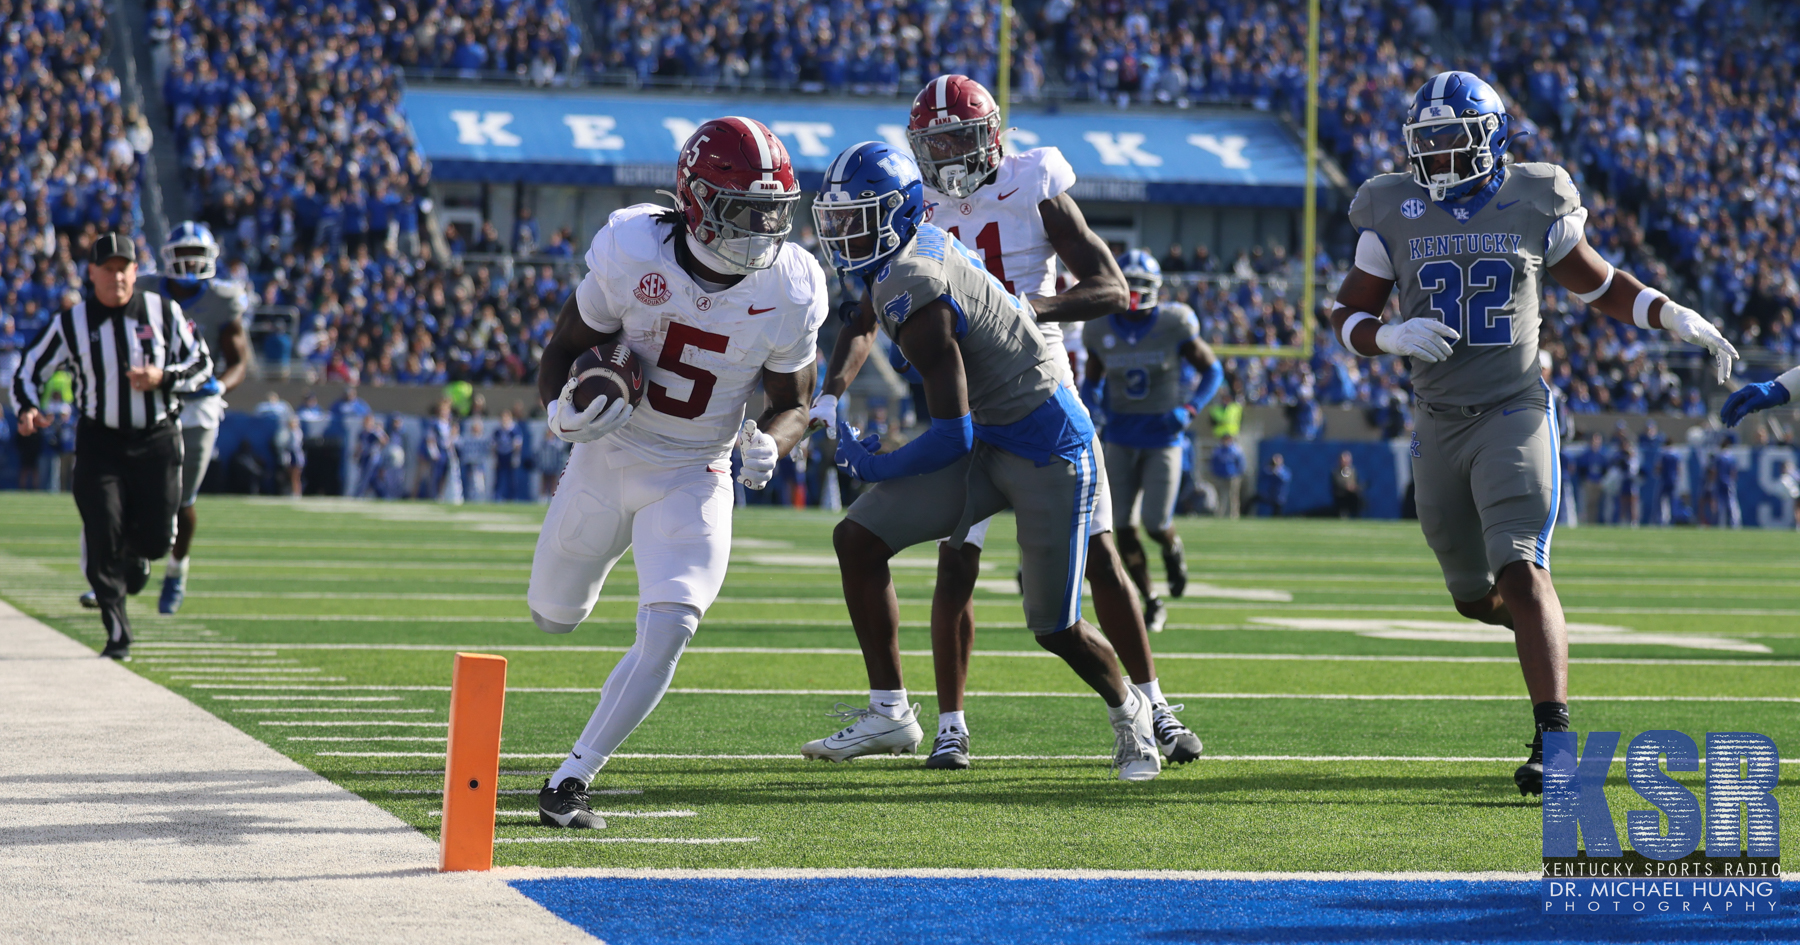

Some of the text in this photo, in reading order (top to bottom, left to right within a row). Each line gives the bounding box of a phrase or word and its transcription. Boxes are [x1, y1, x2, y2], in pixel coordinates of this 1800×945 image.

[934, 117, 952, 126] BAMA
[686, 134, 711, 168] 5
[1402, 199, 1425, 218] SEC
[1408, 233, 1522, 261] KENTUCKY
[641, 274, 666, 297] SEC
[636, 293, 667, 306] GRADUATE
[1417, 258, 1515, 347] 32
[646, 321, 729, 420] 5
